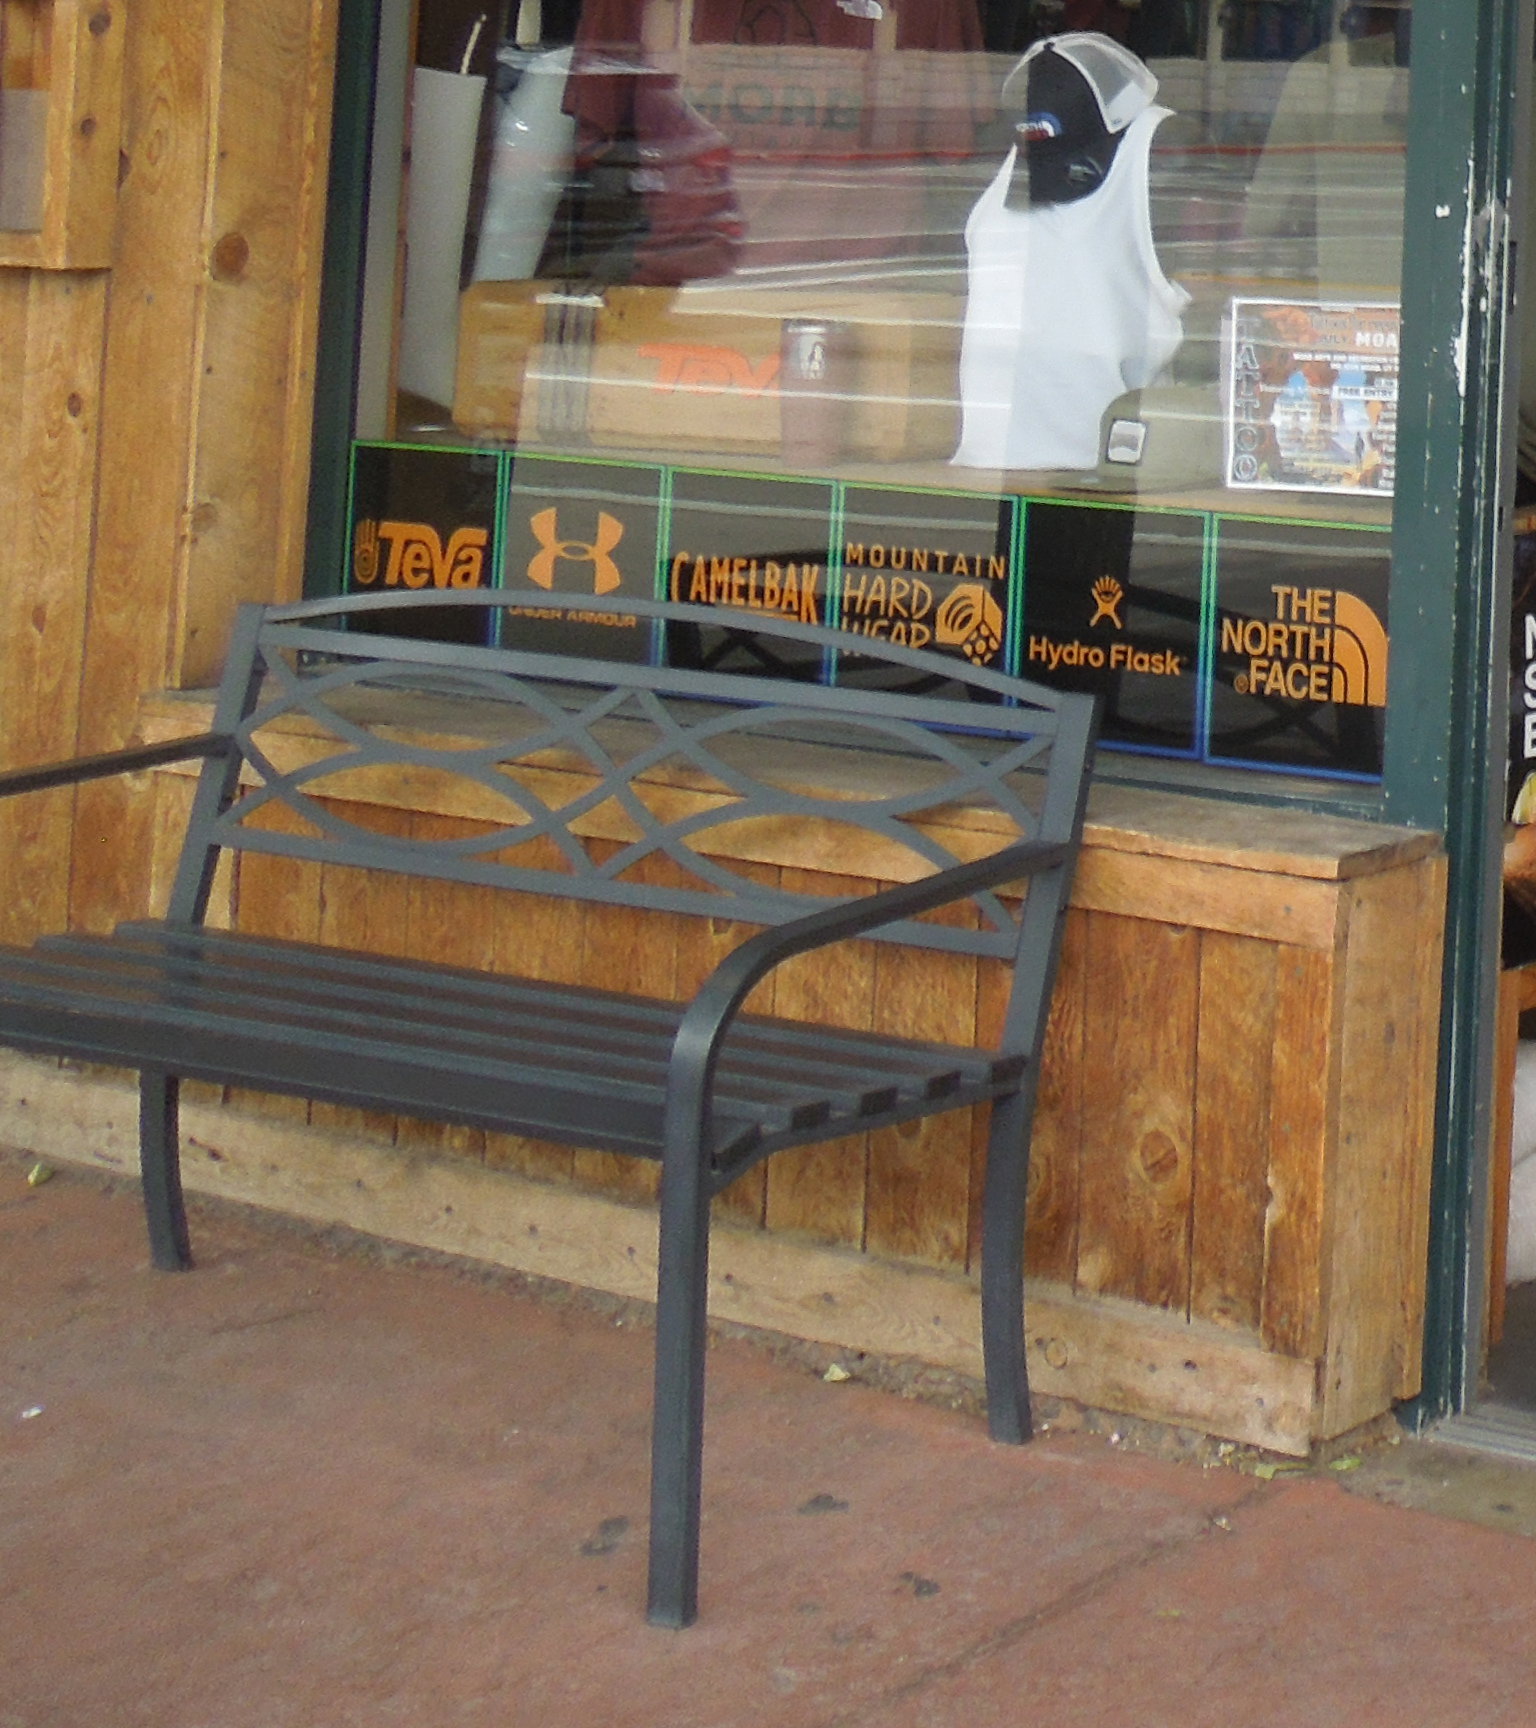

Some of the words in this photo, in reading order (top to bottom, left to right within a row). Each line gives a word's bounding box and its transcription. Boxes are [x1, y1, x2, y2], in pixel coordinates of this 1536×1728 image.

[637, 341, 782, 400] Tev
[378, 521, 489, 590] Teva
[844, 541, 1006, 580] MOUNTAIN
[671, 551, 821, 626] CAMELBAK
[842, 573, 933, 621] HARD
[1271, 584, 1333, 625] THE
[1029, 635, 1104, 668] Hydro
[1110, 643, 1181, 676] Flask
[1221, 617, 1333, 663] NORTH
[1248, 657, 1330, 702] FACE
